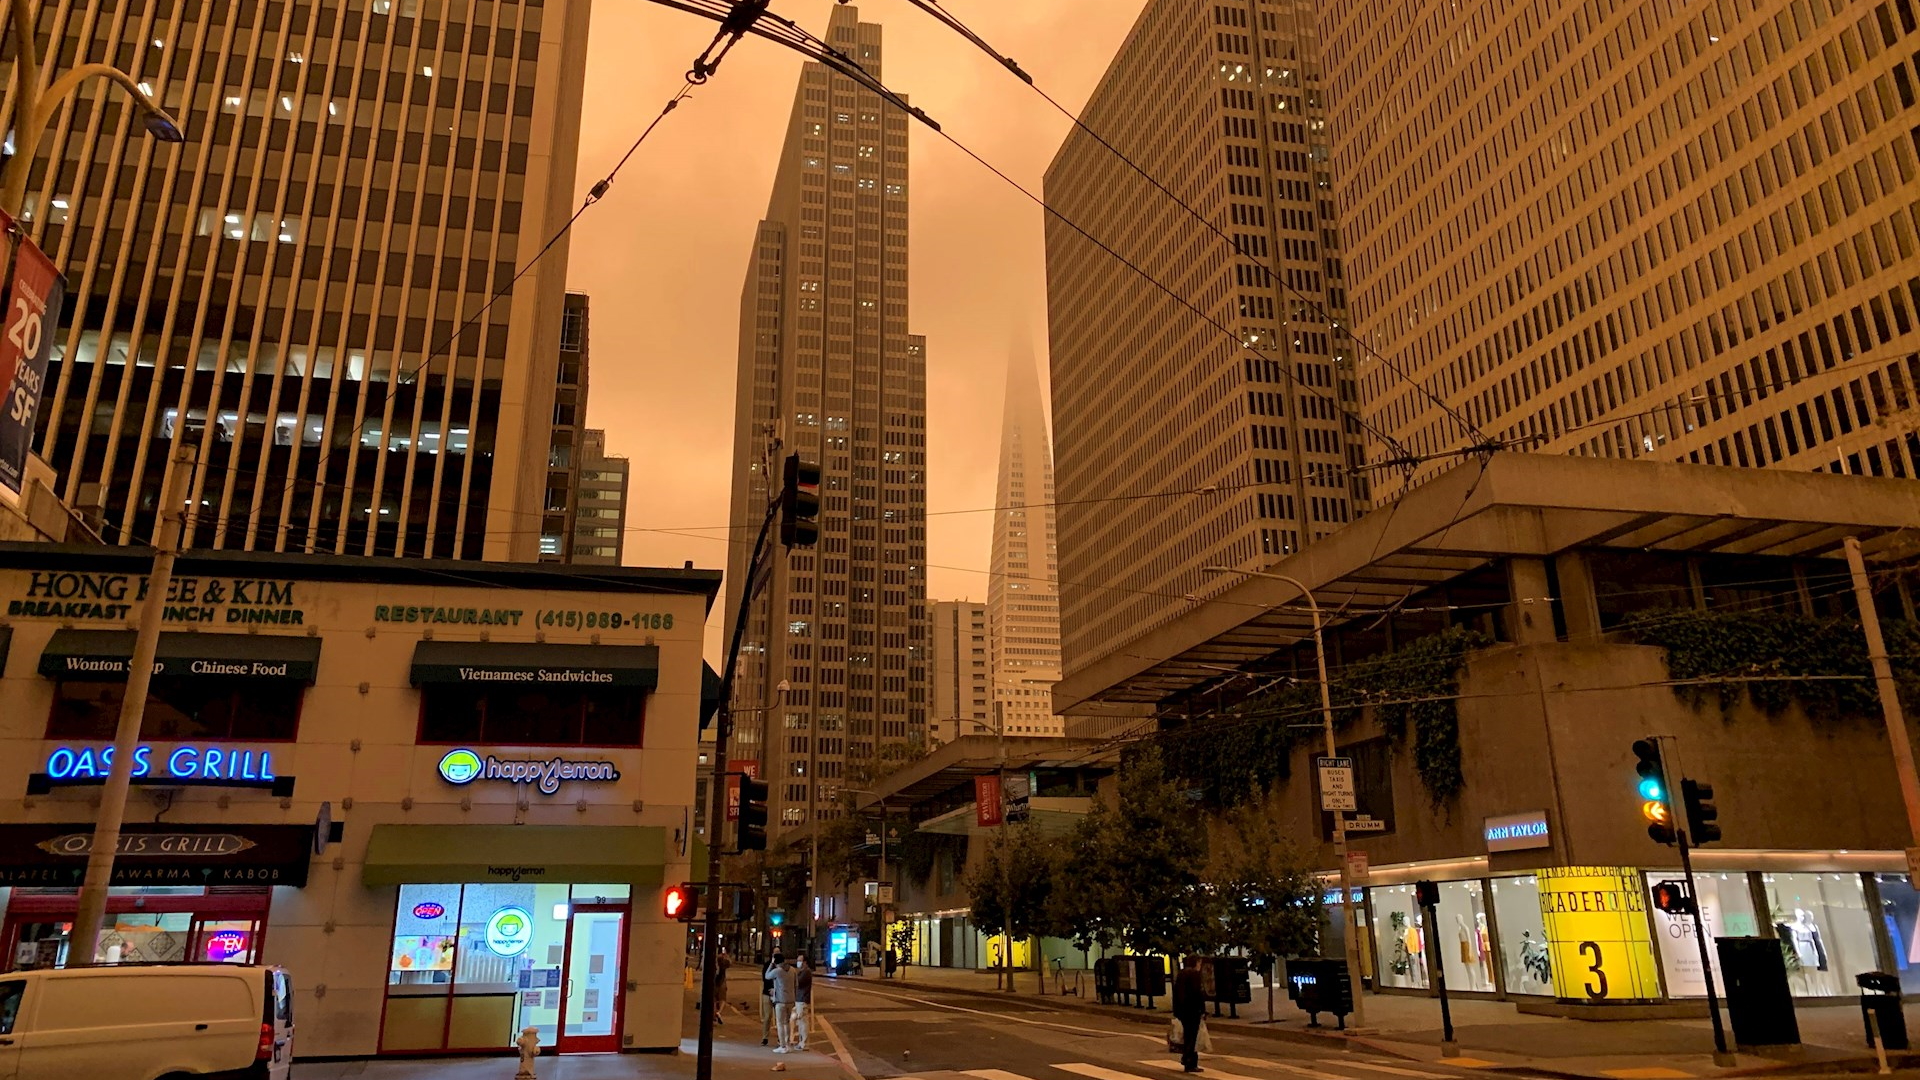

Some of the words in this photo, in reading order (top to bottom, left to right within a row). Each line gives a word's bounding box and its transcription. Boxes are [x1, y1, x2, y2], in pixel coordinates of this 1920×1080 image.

[8, 297, 42, 360] 20
[14, 355, 41, 394] YEARS
[10, 387, 35, 427] SF
[27, 572, 128, 601] HONG
[203, 580, 226, 604] &
[230, 579, 296, 606] KIM
[8, 600, 132, 620] BREAKFAST
[226, 608, 304, 625] DINNER
[374, 604, 523, 627] RESTAURANT
[65, 657, 123, 672] Wonton
[126, 658, 165, 675] Sp
[191, 660, 248, 676] Chinese
[251, 662, 287, 677] Food
[459, 667, 534, 682] Vietnamese
[538, 668, 613, 684] Sandwiches
[47, 746, 153, 779] OASS
[168, 746, 276, 781] GRILL
[1336, 760, 1350, 768] LANE
[1488, 827, 1509, 840] ANN
[1511, 822, 1548, 837] TAYLOR
[160, 836, 226, 852] GRILL
[115, 868, 191, 880] AWARMA
[223, 868, 279, 880] KABOB
[414, 905, 442, 917] OPEN
[1579, 941, 1608, 1001] 3
